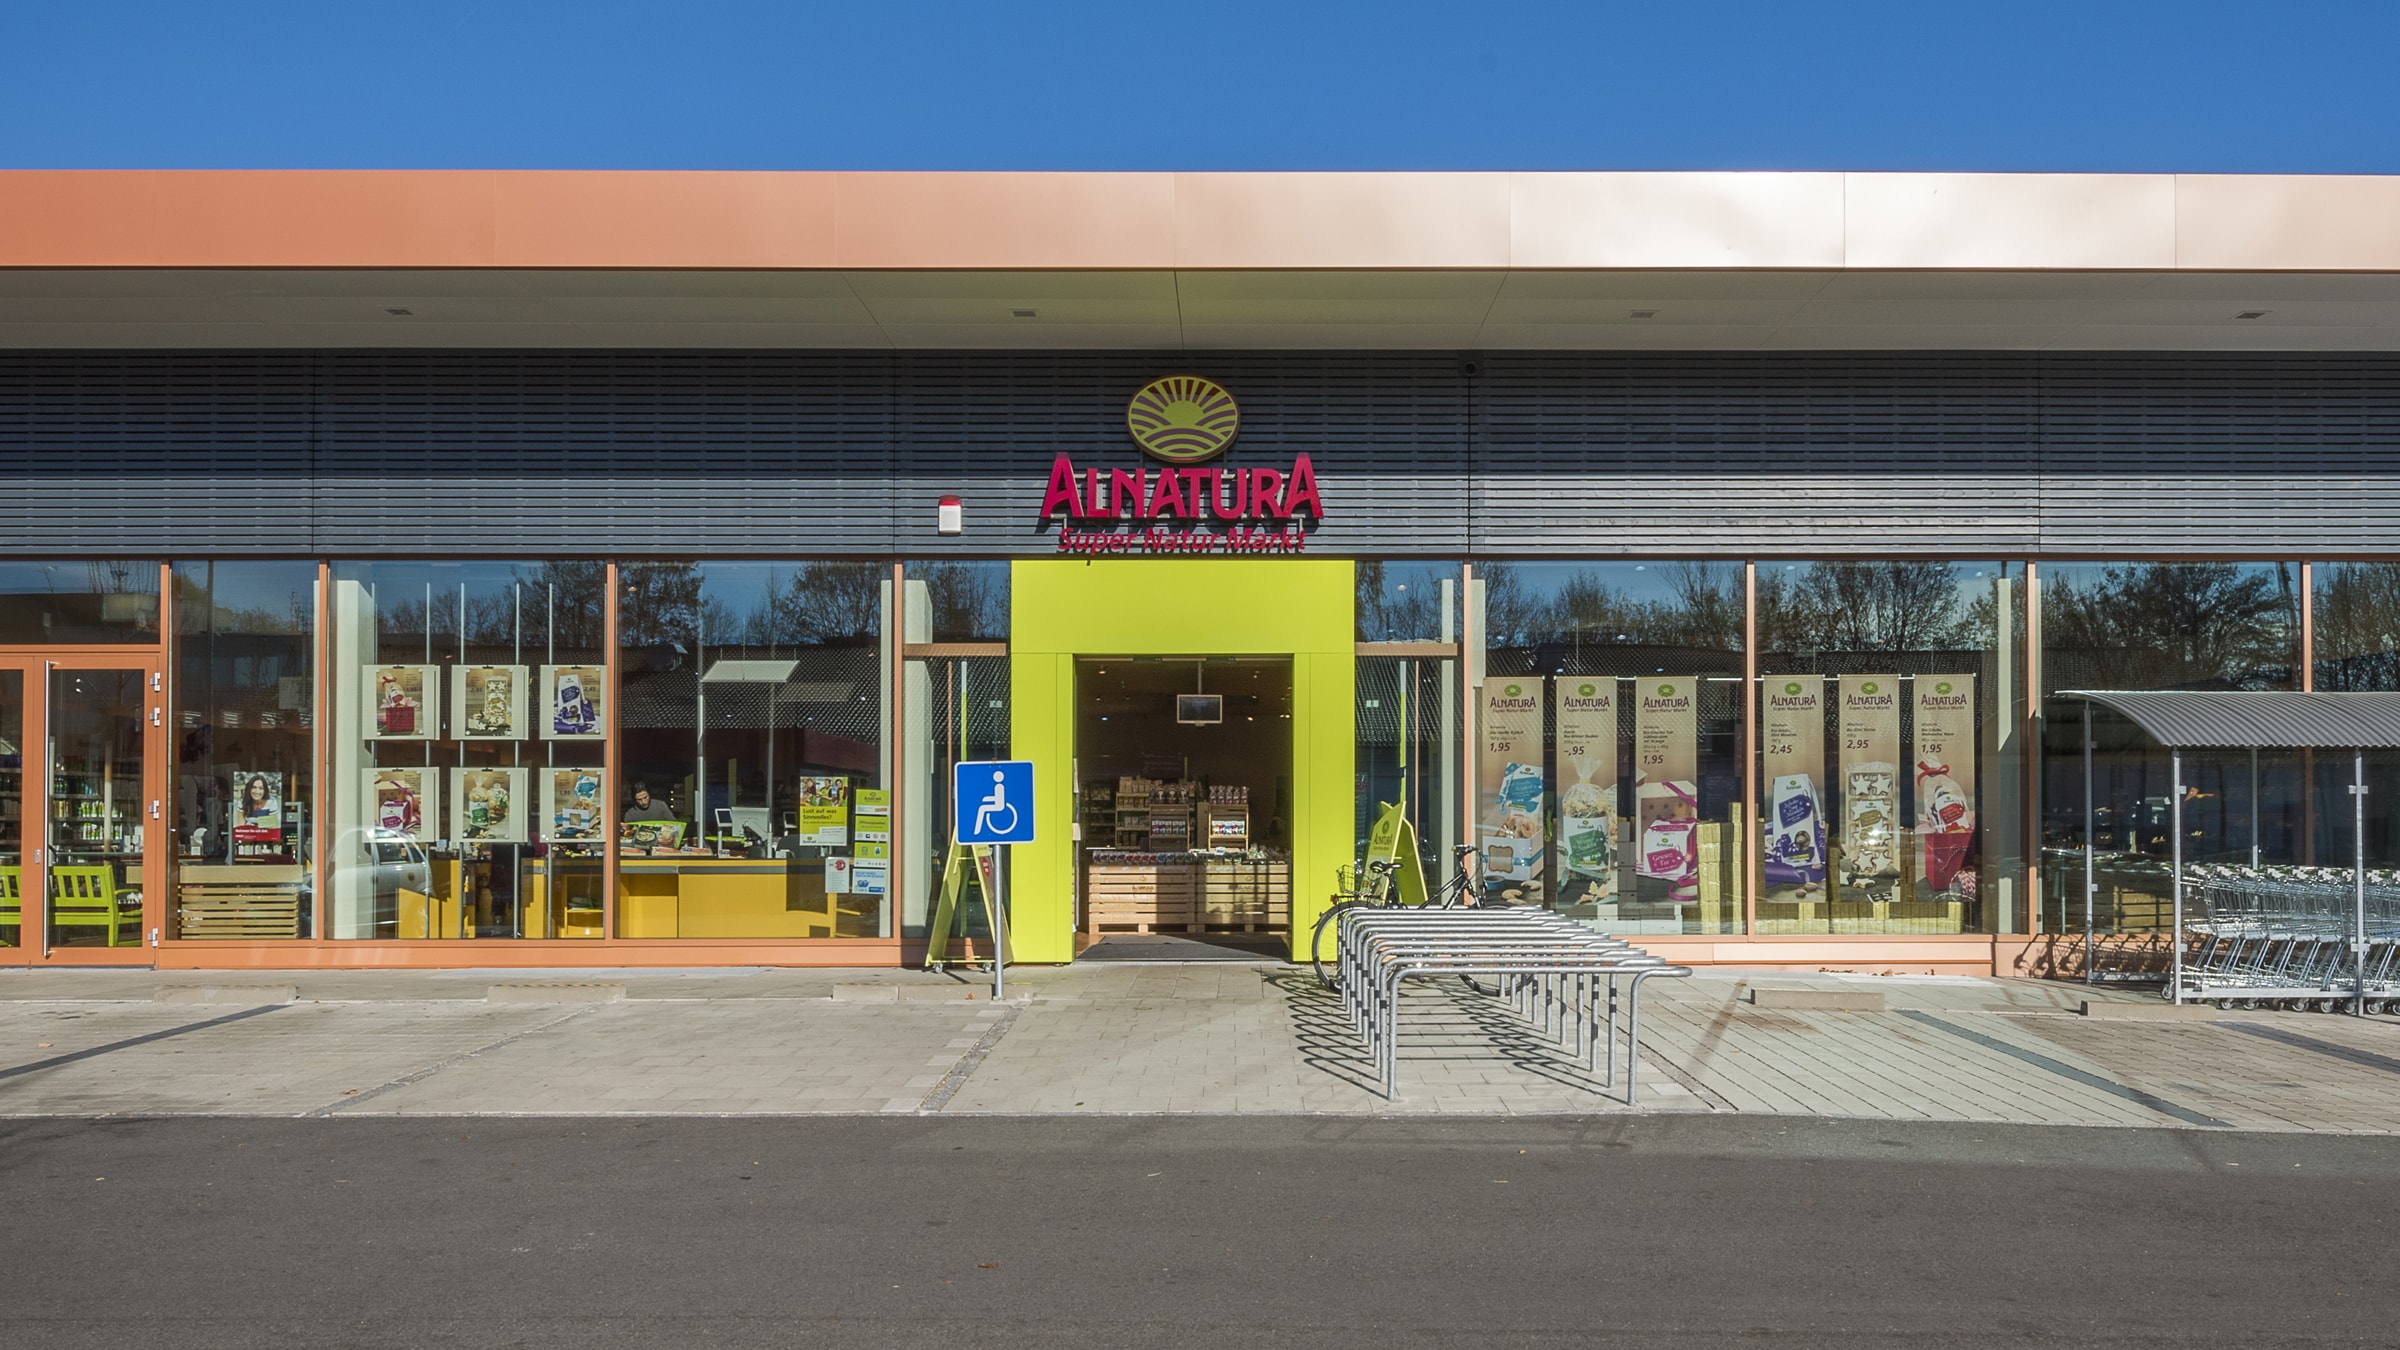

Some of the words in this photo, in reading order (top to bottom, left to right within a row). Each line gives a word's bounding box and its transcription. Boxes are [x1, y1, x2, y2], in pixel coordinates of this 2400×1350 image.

[1041, 452, 1324, 519] ALNATURA
[1058, 527, 1137, 555] Super
[1143, 528, 1220, 550] Natur
[1226, 527, 1307, 549] Markt
[1490, 696, 1536, 708] ALNATURA
[1564, 696, 1610, 707] ALNATURA
[1643, 696, 1689, 708] ALNATURA
[1770, 694, 1816, 706] ALNATURA
[1847, 693, 1893, 705] ALNATURA
[1921, 694, 1967, 705] ALNATURA
[1490, 742, 1511, 752] 1,95
[1770, 745, 1793, 755] 2,45
[1846, 739, 1869, 750] 2,95
[1921, 744, 1942, 754] 1,95
[1643, 754, 1664, 765] 1,95
